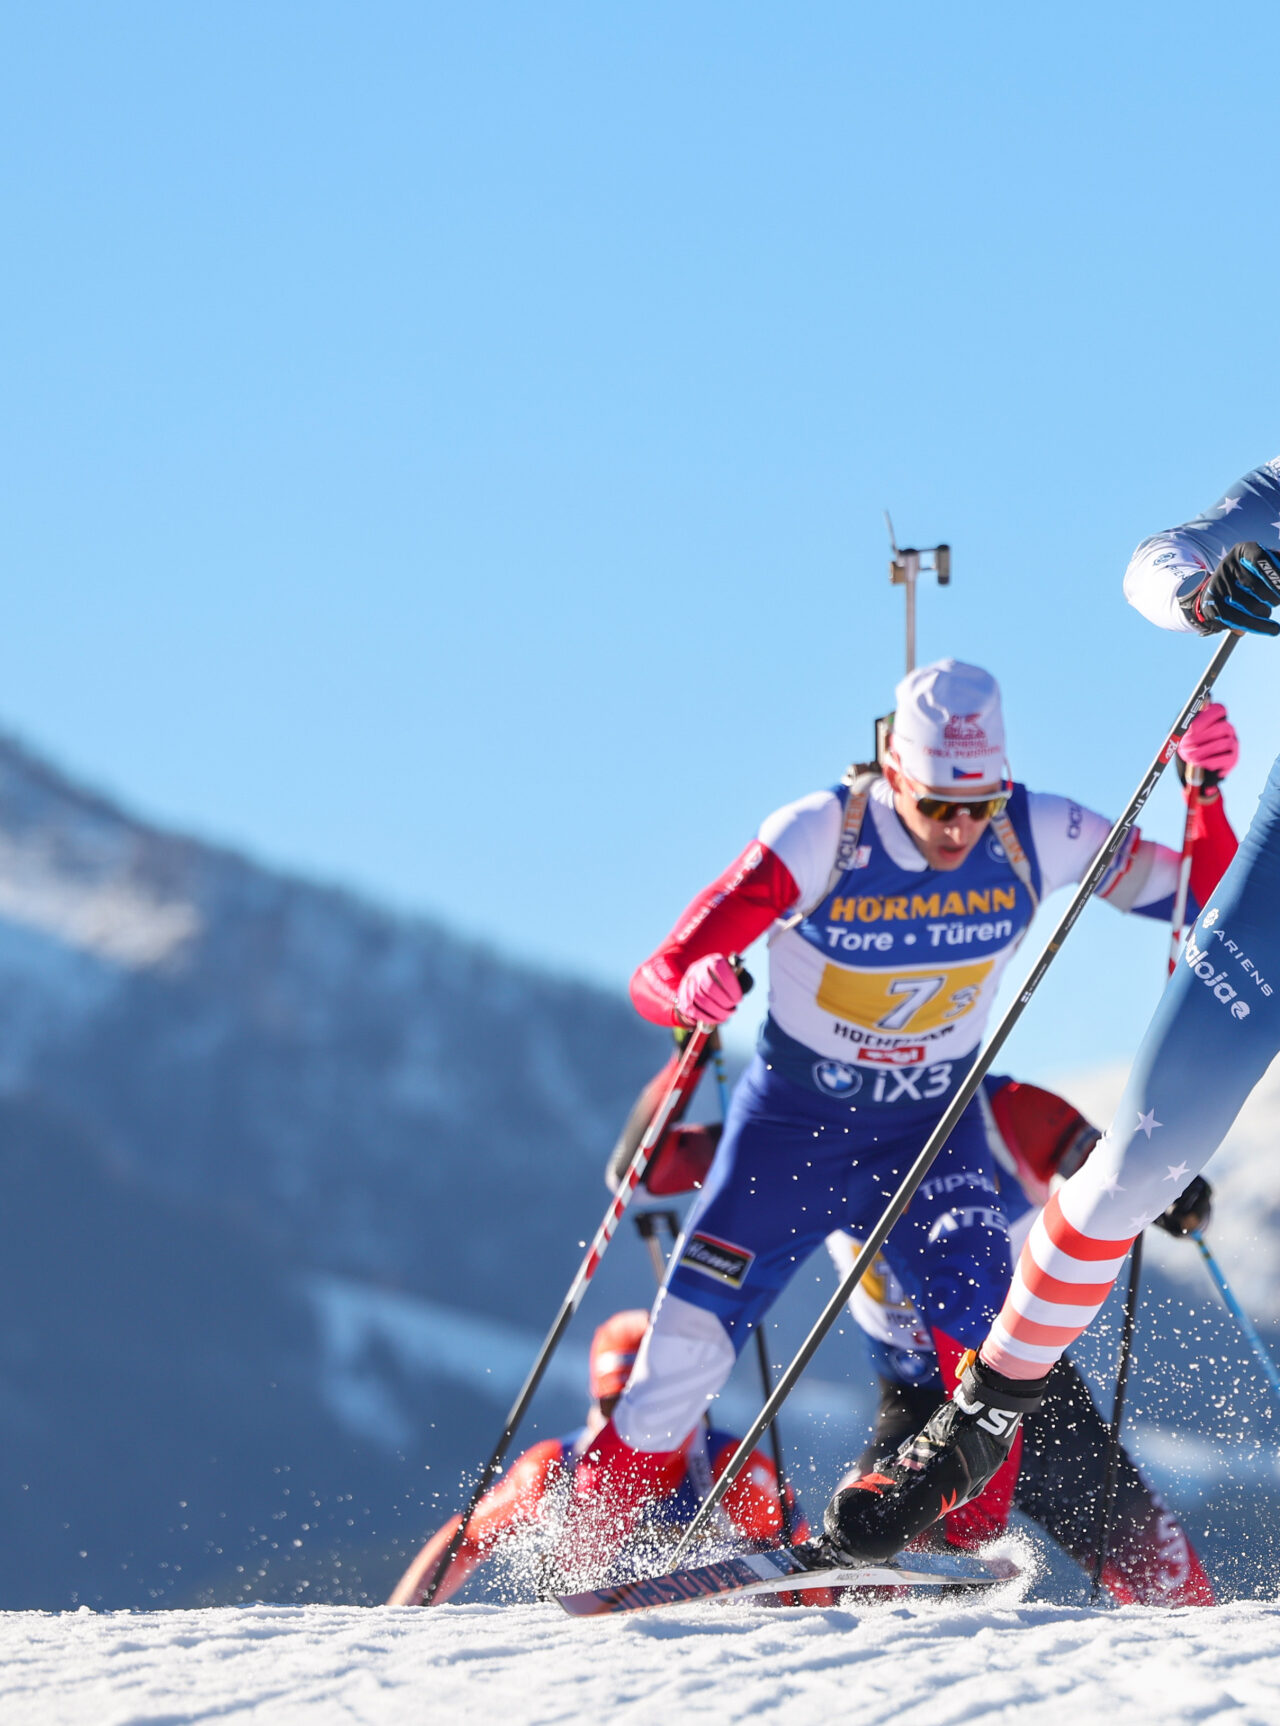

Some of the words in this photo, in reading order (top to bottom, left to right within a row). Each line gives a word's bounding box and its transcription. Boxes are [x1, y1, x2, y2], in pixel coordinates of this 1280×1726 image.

[829, 886, 1016, 922] HÖRMANN
[825, 925, 894, 951] Tore
[926, 920, 1012, 947] Türen
[1213, 930, 1274, 997] ARIENS
[874, 974, 948, 1031] 7
[873, 1063, 952, 1102] iX3
